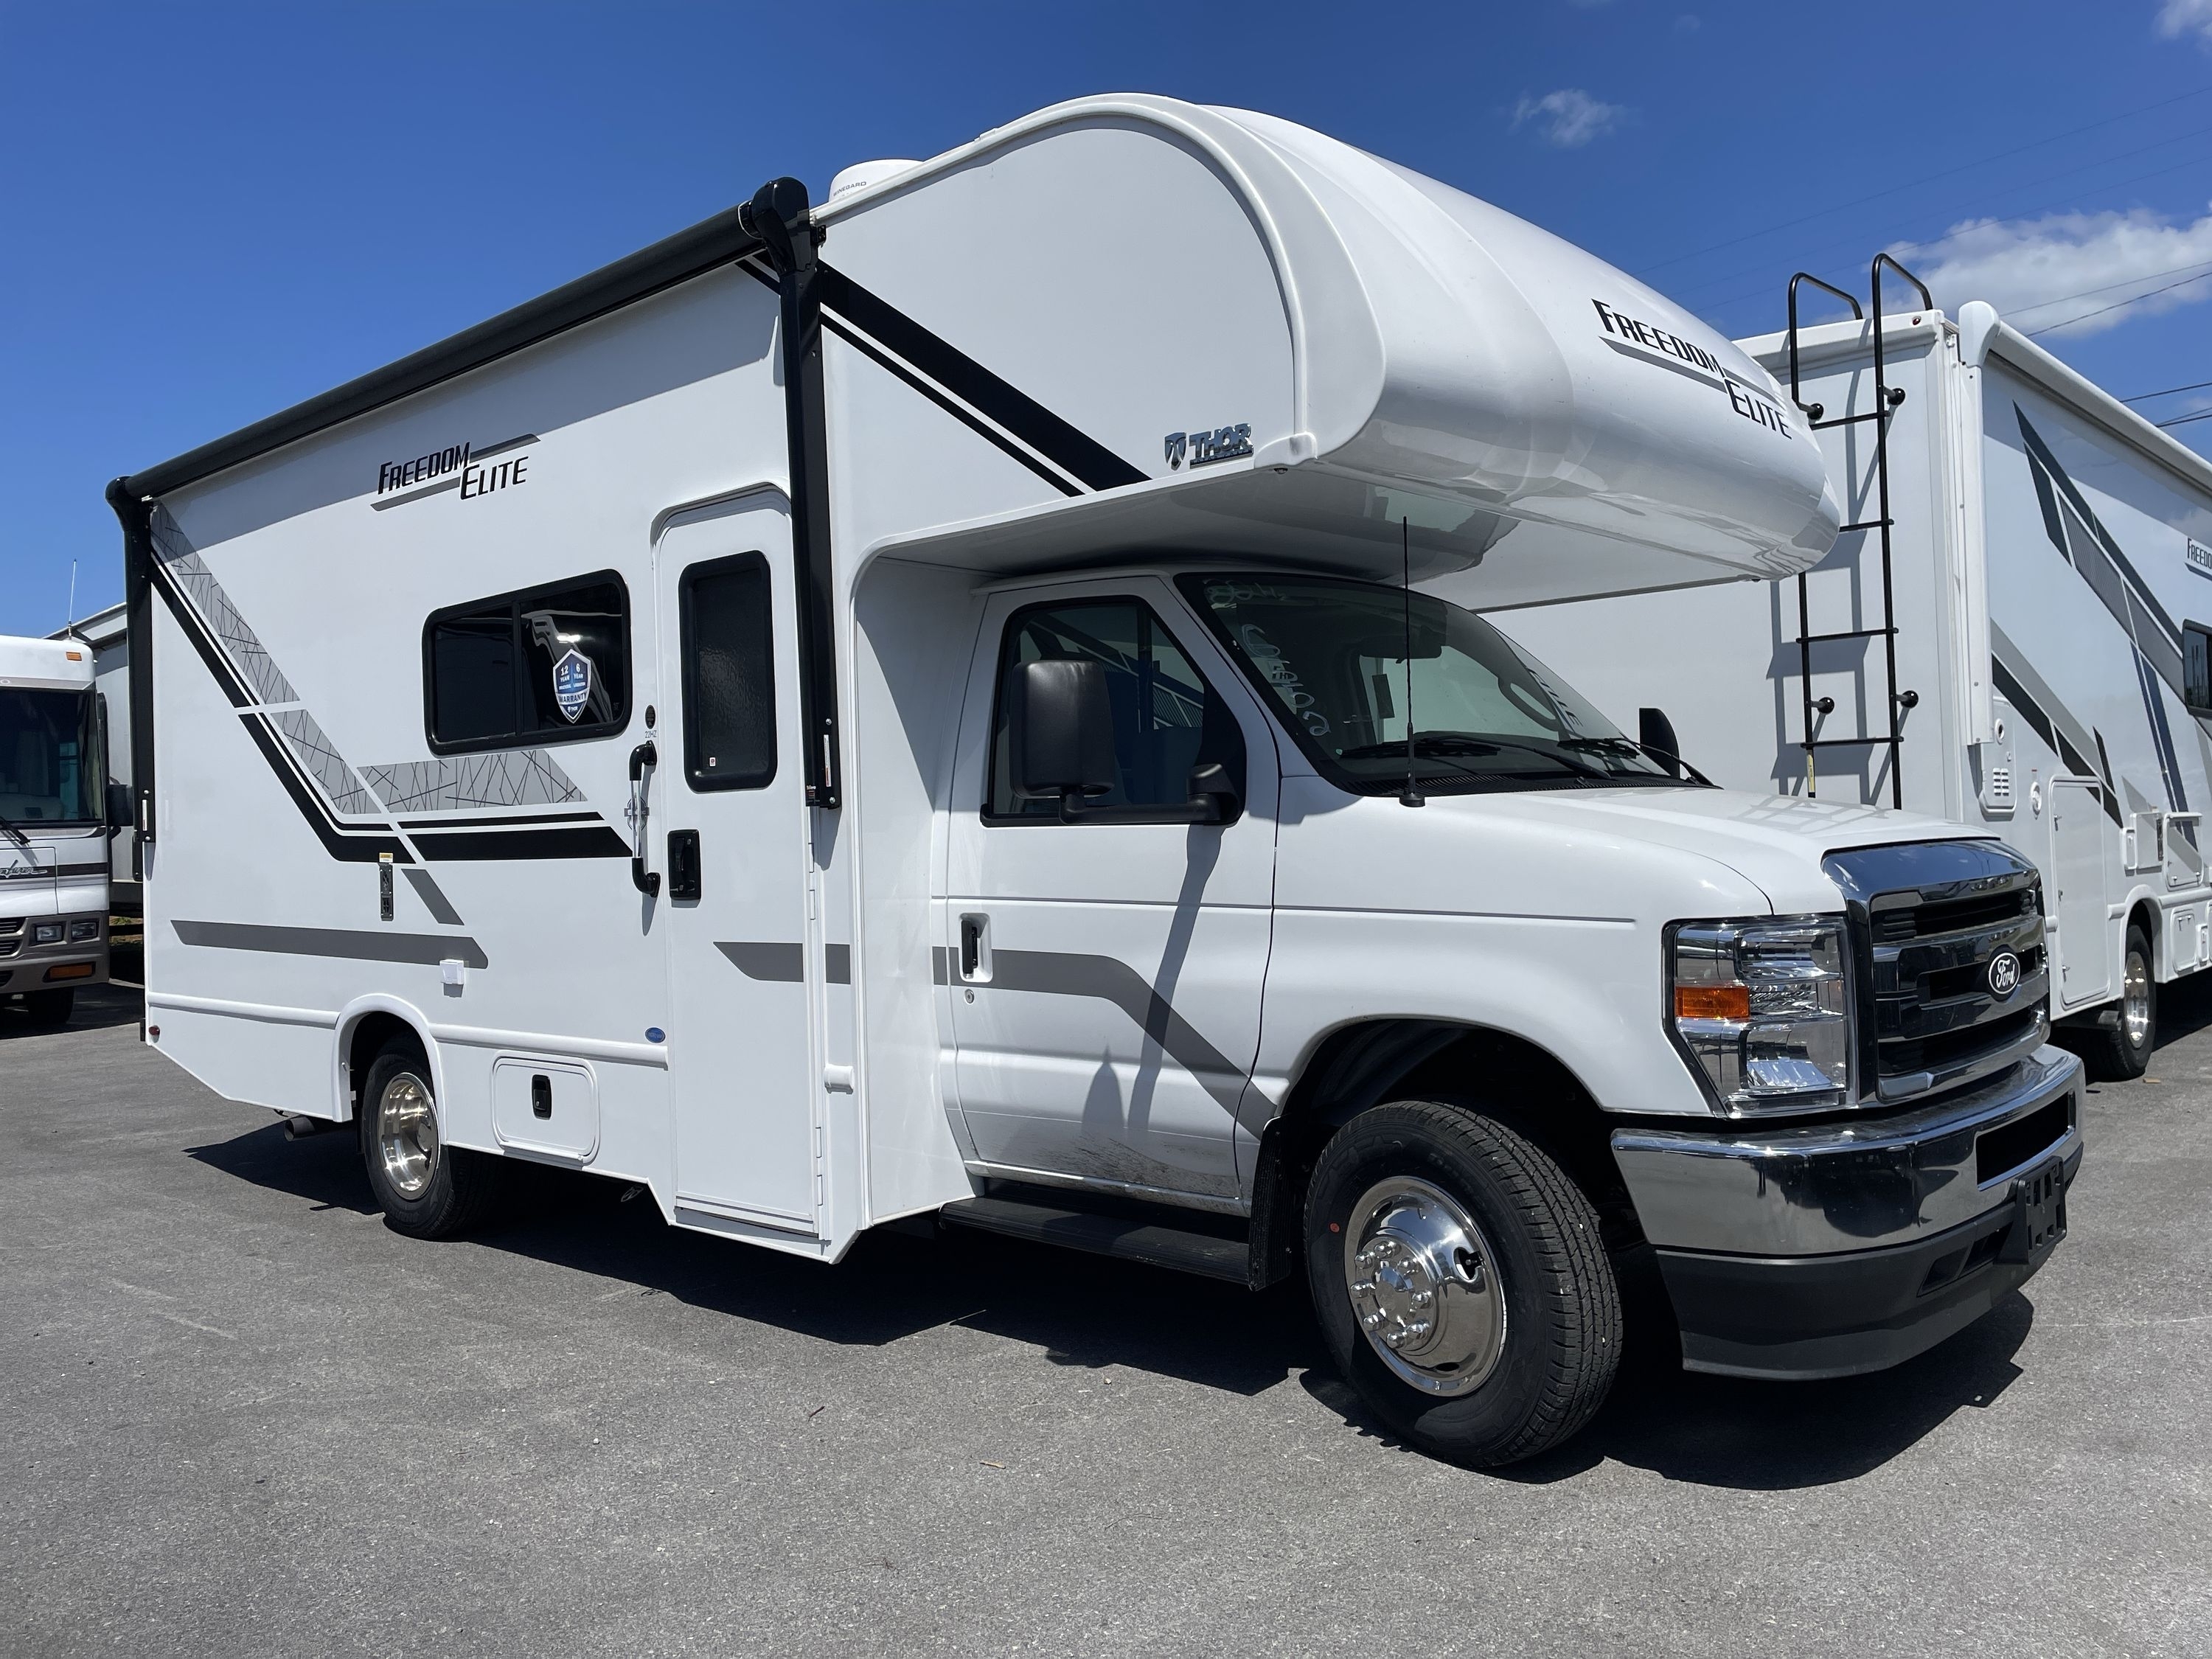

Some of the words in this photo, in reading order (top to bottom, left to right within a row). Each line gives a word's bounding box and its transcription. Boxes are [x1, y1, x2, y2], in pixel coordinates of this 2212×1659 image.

[1591, 298, 1725, 378] FREEDOM
[1724, 378, 1792, 439] ELITE
[1189, 422, 1253, 461] THOR
[378, 442, 470, 495] FREEDOM
[460, 456, 529, 500] ELITE
[560, 665, 568, 676] 12
[576, 663, 580, 673] 6
[558, 692, 587, 703] WARRANTY
[1996, 959, 2015, 988] Ford
